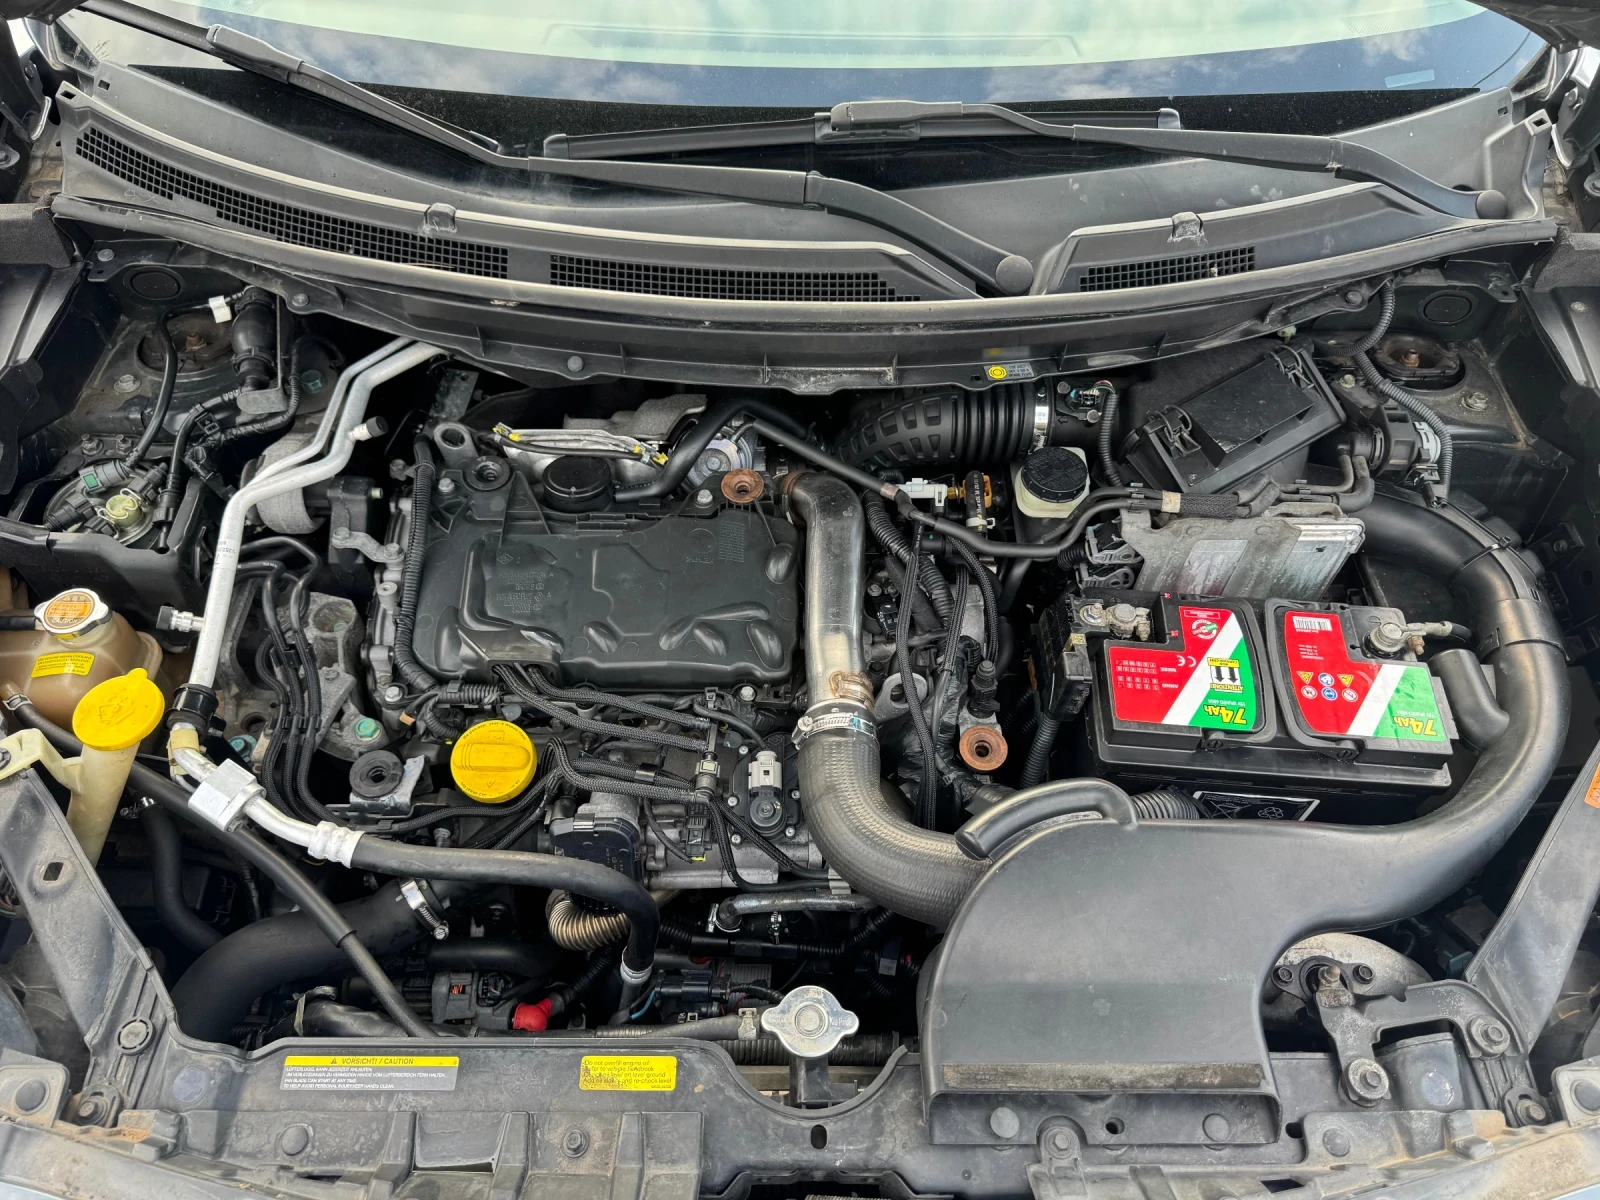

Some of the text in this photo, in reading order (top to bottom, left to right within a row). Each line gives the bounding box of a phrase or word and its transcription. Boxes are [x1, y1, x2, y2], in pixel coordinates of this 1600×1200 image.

[1204, 704, 1247, 725] 74Ah
[1393, 716, 1437, 736] 74Ah
[830, 1016, 855, 1026] Kia Pride
